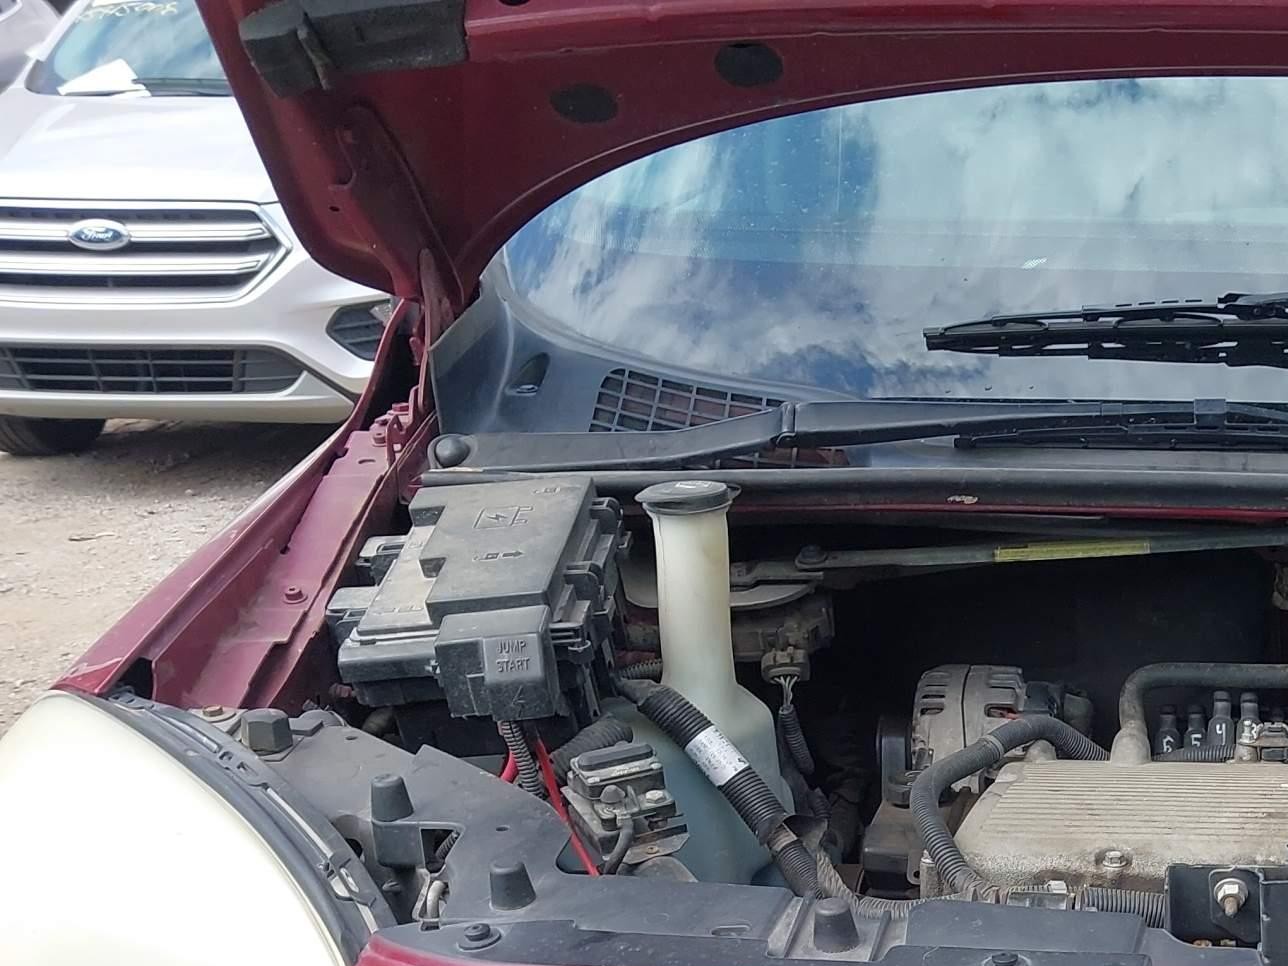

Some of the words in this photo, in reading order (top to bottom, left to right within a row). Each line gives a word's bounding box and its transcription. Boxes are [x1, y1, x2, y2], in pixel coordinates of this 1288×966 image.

[80, 228, 115, 241] Ford
[497, 639, 527, 654] JUMP
[496, 657, 530, 673] START
[1215, 722, 1226, 746] 4
